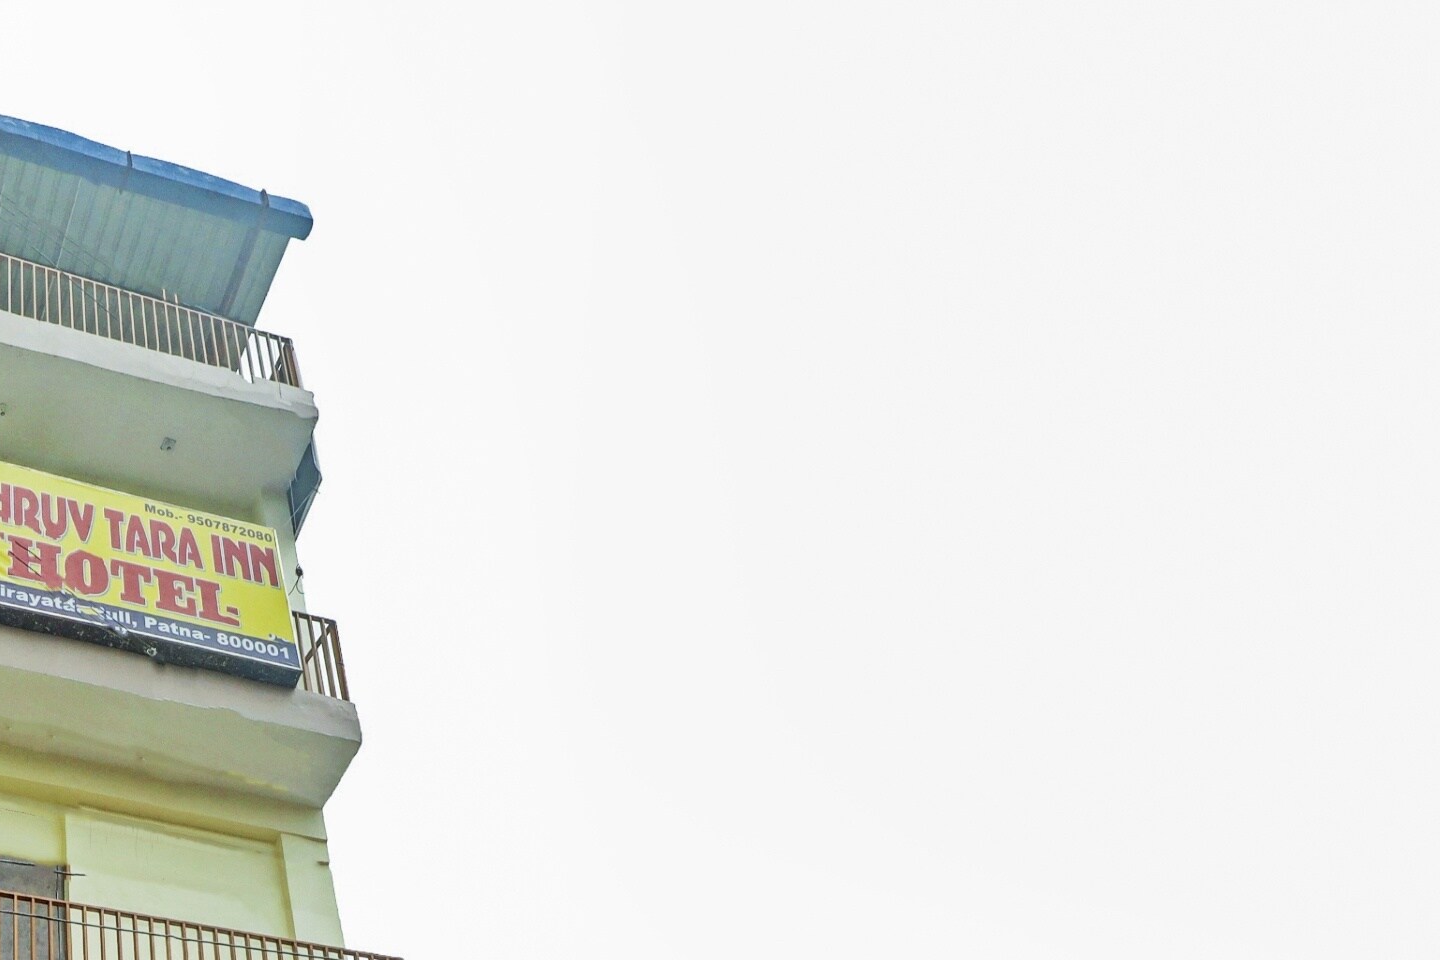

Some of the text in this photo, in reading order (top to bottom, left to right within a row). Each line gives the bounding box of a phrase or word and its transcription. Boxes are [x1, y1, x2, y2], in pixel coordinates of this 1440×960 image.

[104, 508, 203, 569] TARA
[211, 534, 278, 587] INN
[187, 514, 272, 543] 9507872080
[7, 535, 240, 627] HOTEL
[144, 616, 210, 642] Patna-
[217, 632, 290, 660] 800001
